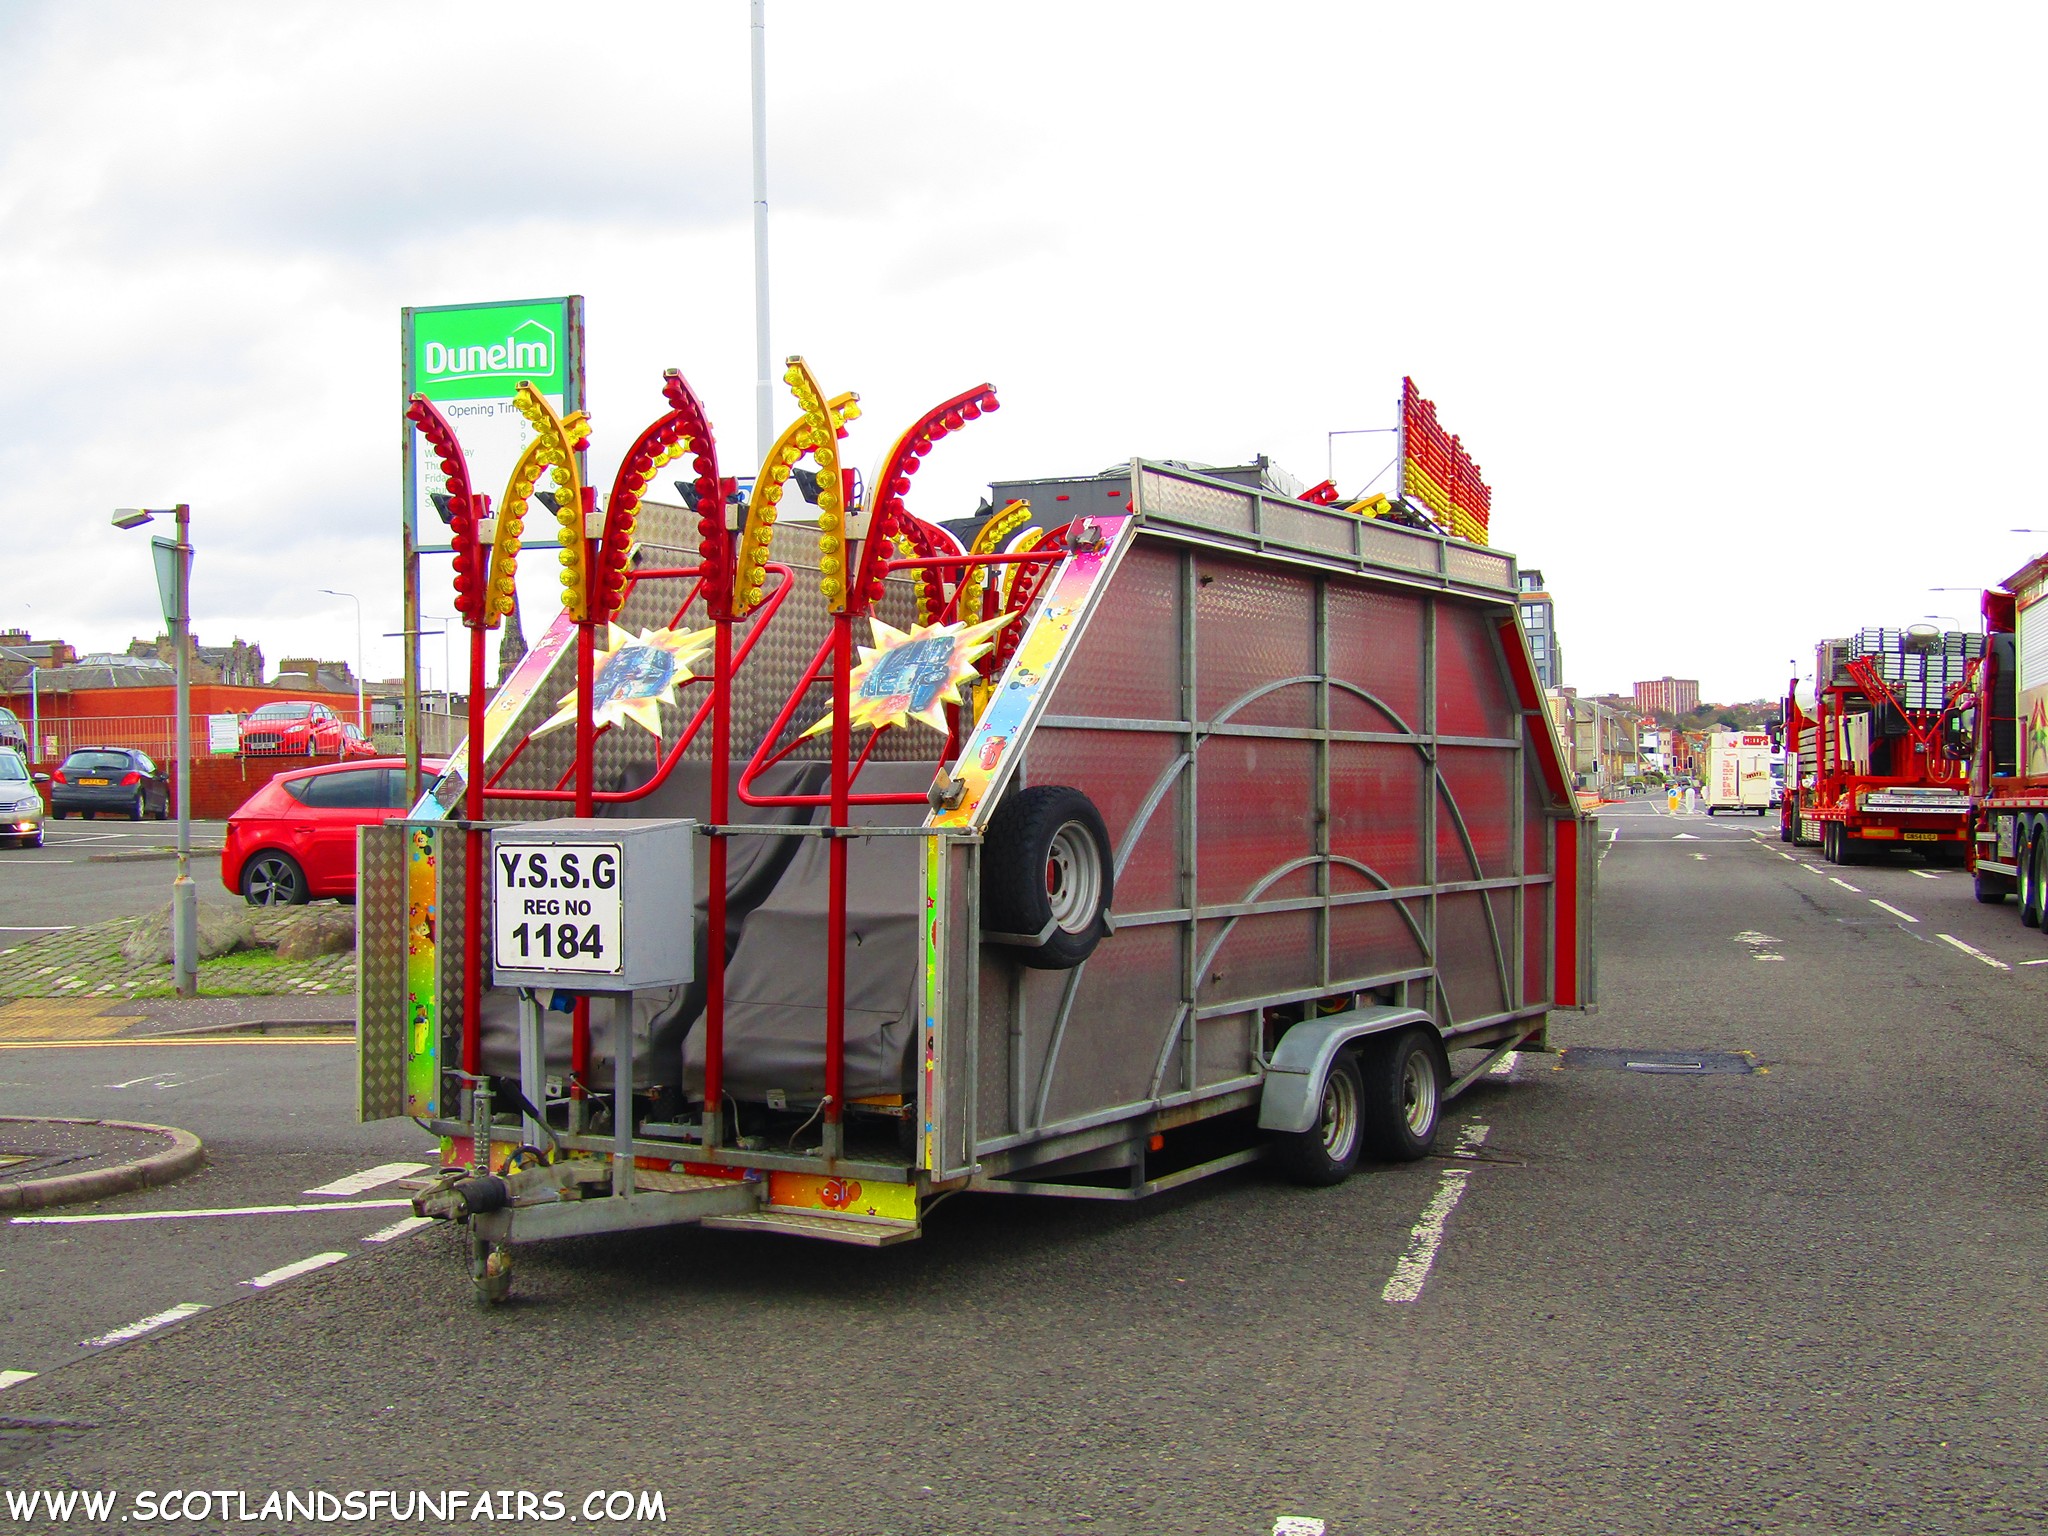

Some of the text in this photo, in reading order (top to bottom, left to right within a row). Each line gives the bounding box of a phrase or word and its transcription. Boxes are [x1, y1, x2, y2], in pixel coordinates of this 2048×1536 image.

[426, 337, 547, 374] Dunelm
[448, 402, 523, 418] Opening Tim
[520, 419, 526, 429] 9
[520, 432, 526, 441] 9
[499, 853, 616, 889] Y.S.S.G
[524, 899, 592, 916] REG NO
[512, 922, 604, 959] 1184
